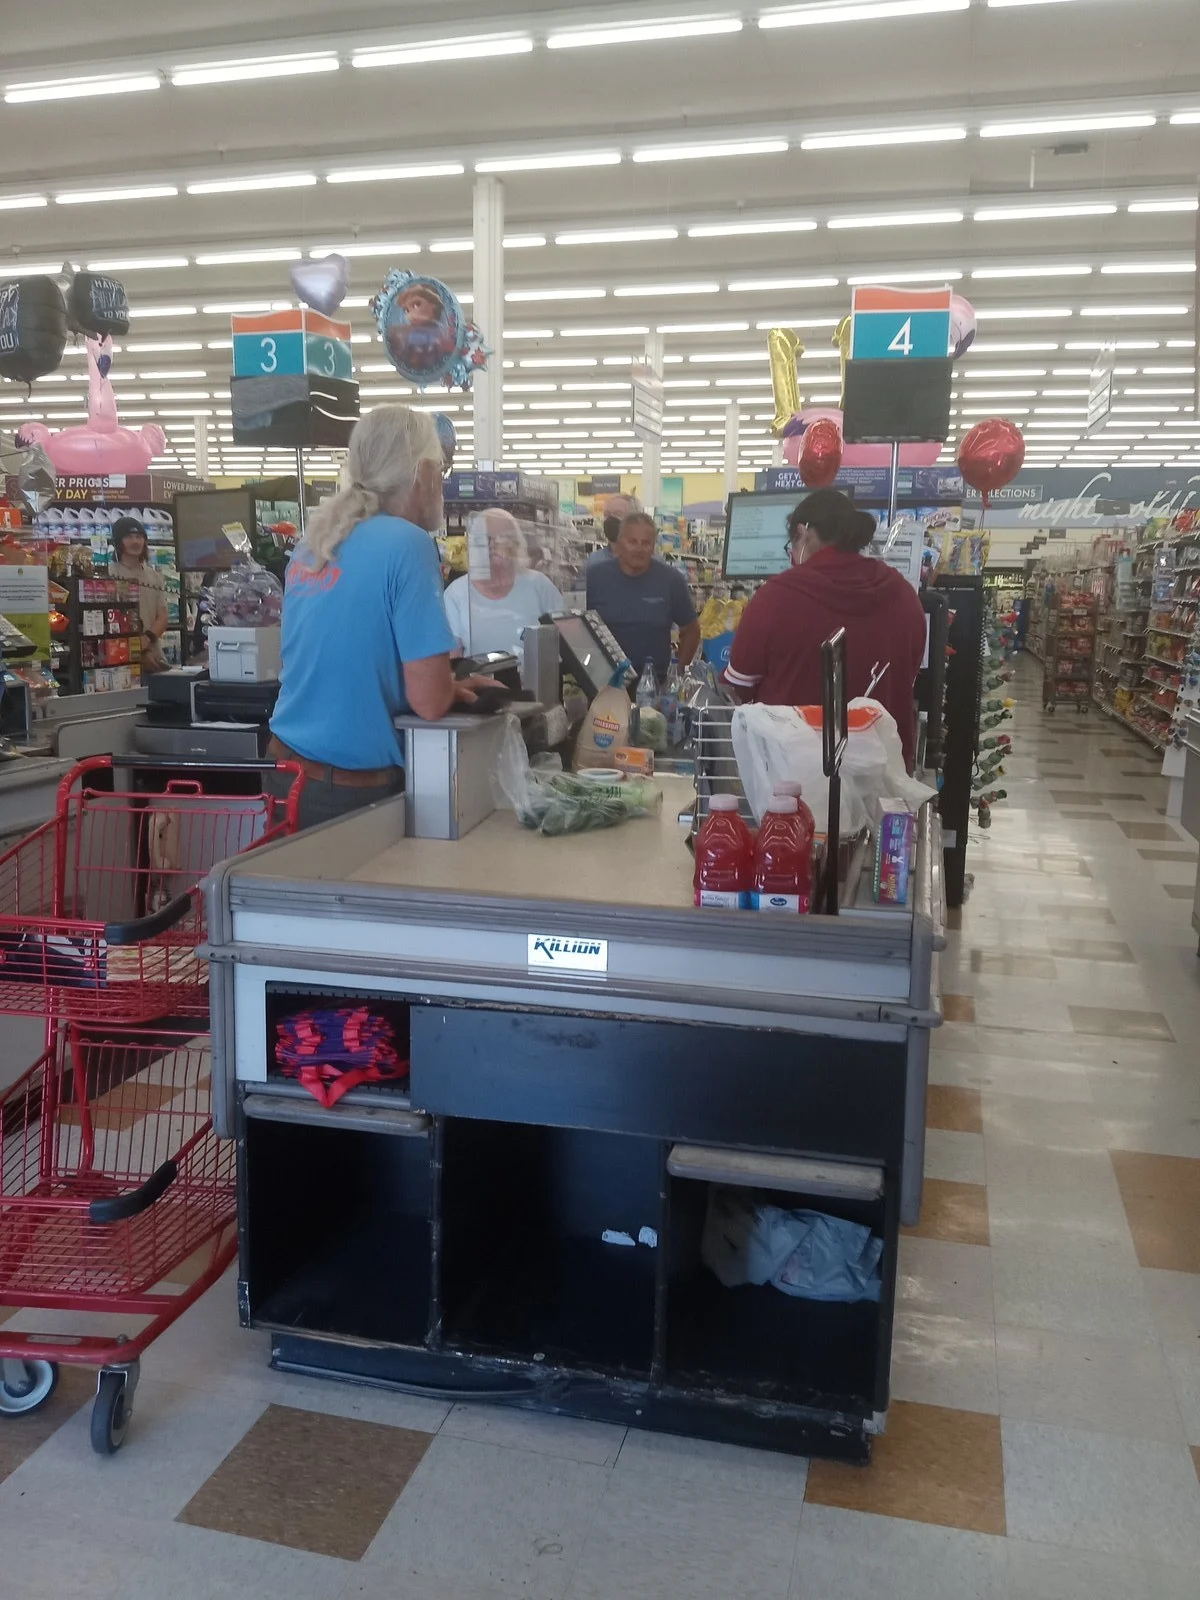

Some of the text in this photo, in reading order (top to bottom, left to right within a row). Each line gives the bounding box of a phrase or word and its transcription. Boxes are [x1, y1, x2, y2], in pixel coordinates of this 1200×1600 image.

[887, 315, 914, 356] 4
[260, 336, 278, 373] 3
[323, 341, 336, 376] 3
[778, 472, 793, 480] GET
[69, 477, 109, 488] PRICS
[163, 480, 185, 492] LOWER
[775, 480, 796, 488] NEXT
[66, 489, 88, 499] DAY
[979, 488, 1036, 498] LECTIONS
